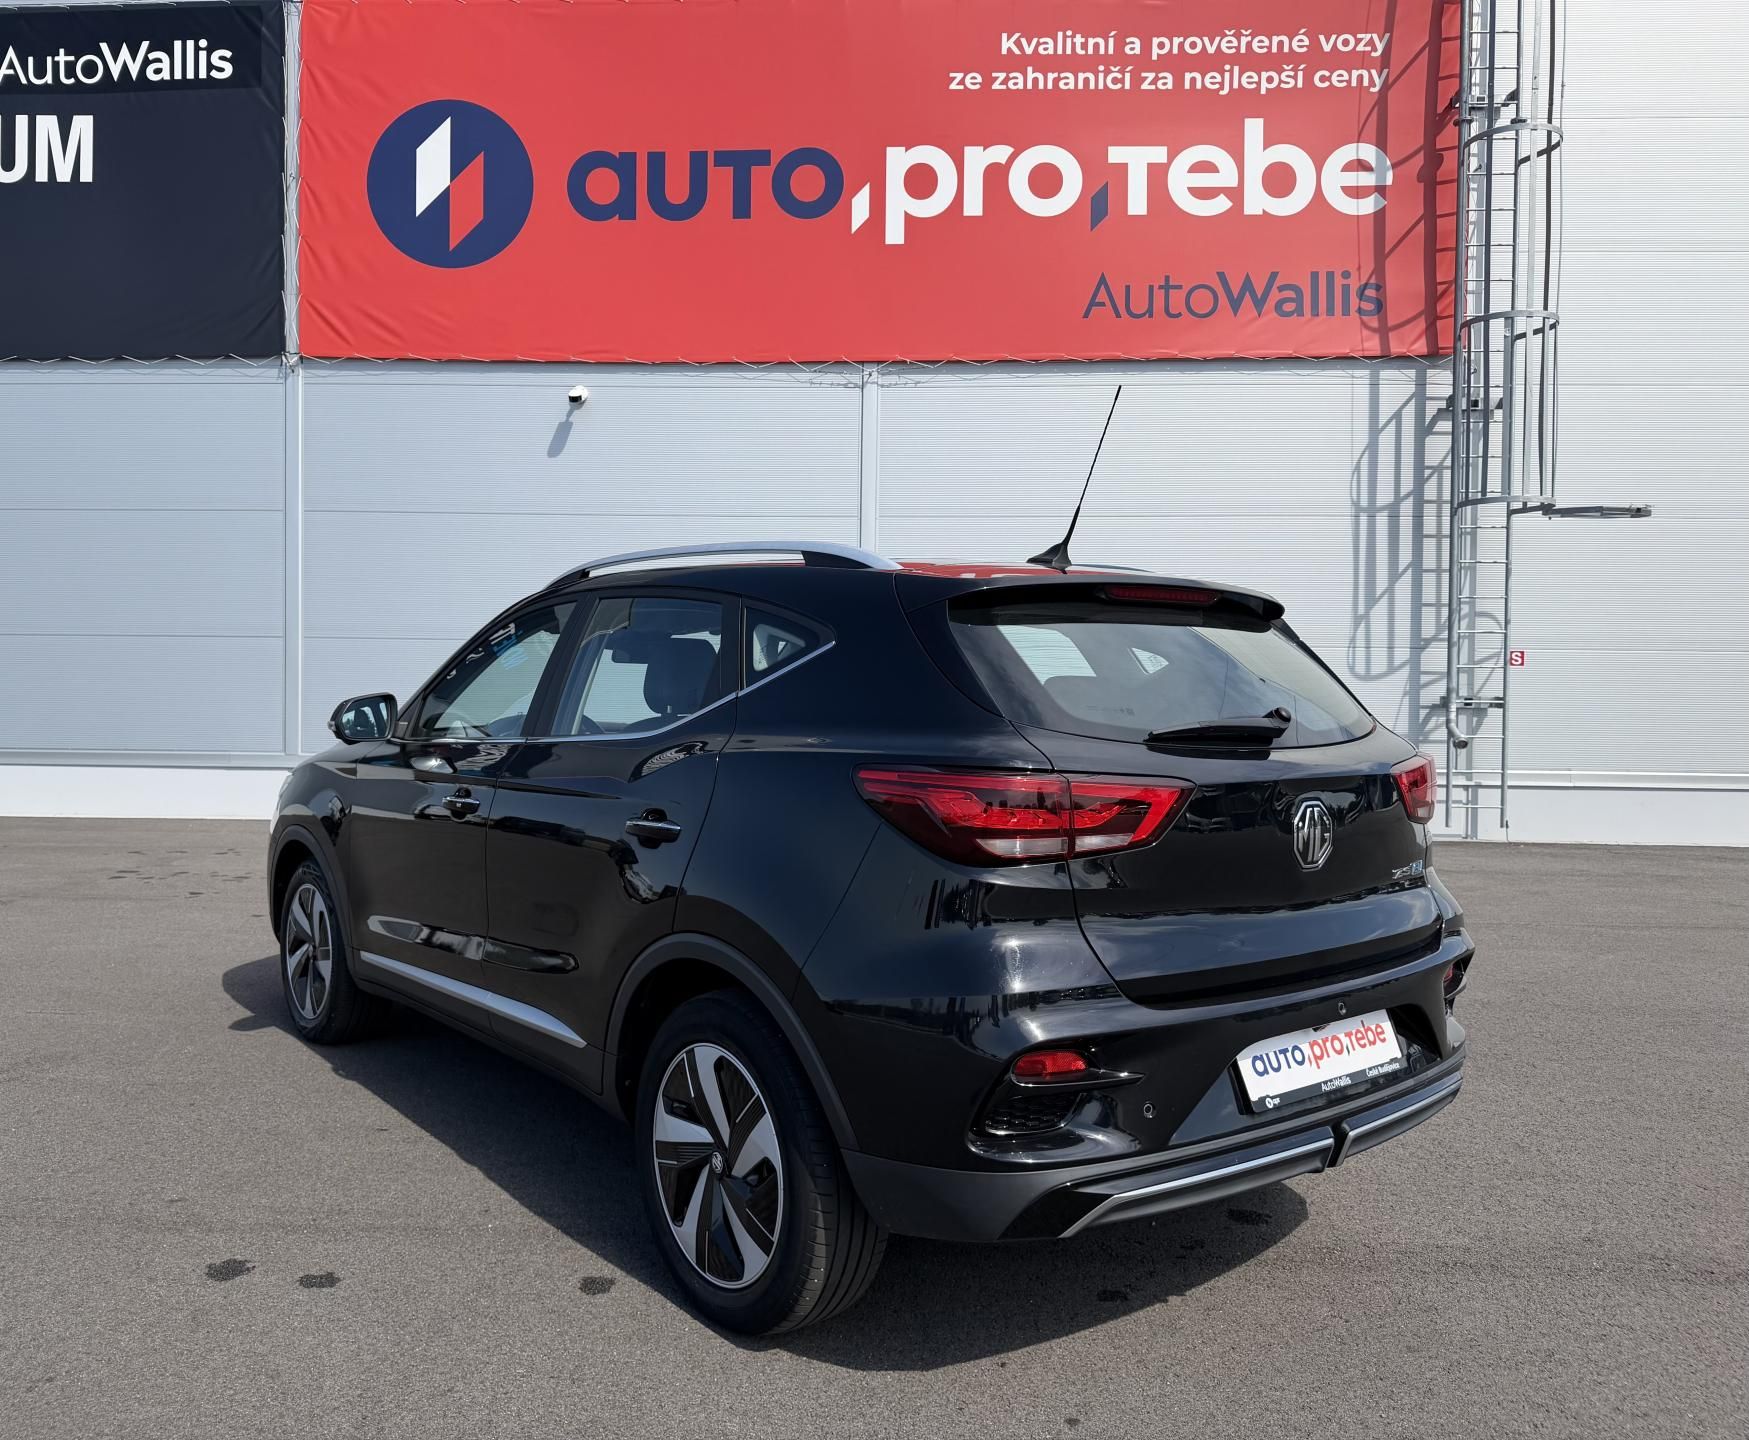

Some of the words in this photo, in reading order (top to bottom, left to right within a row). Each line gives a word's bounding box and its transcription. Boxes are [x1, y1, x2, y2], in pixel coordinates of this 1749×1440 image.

[0, 38, 234, 85] AutoWallis
[1001, 30, 1118, 55] Kvalitní
[1124, 36, 1141, 55] a
[1151, 28, 1310, 61] prověřené
[1318, 33, 1390, 57] vozy
[948, 72, 983, 90] ze
[991, 64, 1134, 90] zahraničí
[1140, 71, 1174, 90] za
[1184, 63, 1307, 96] nejlepší
[1313, 68, 1389, 93] ceny
[1082, 269, 1384, 320] AutoWallis
[1511, 652, 1523, 665] S
[1297, 805, 1332, 865] MG
